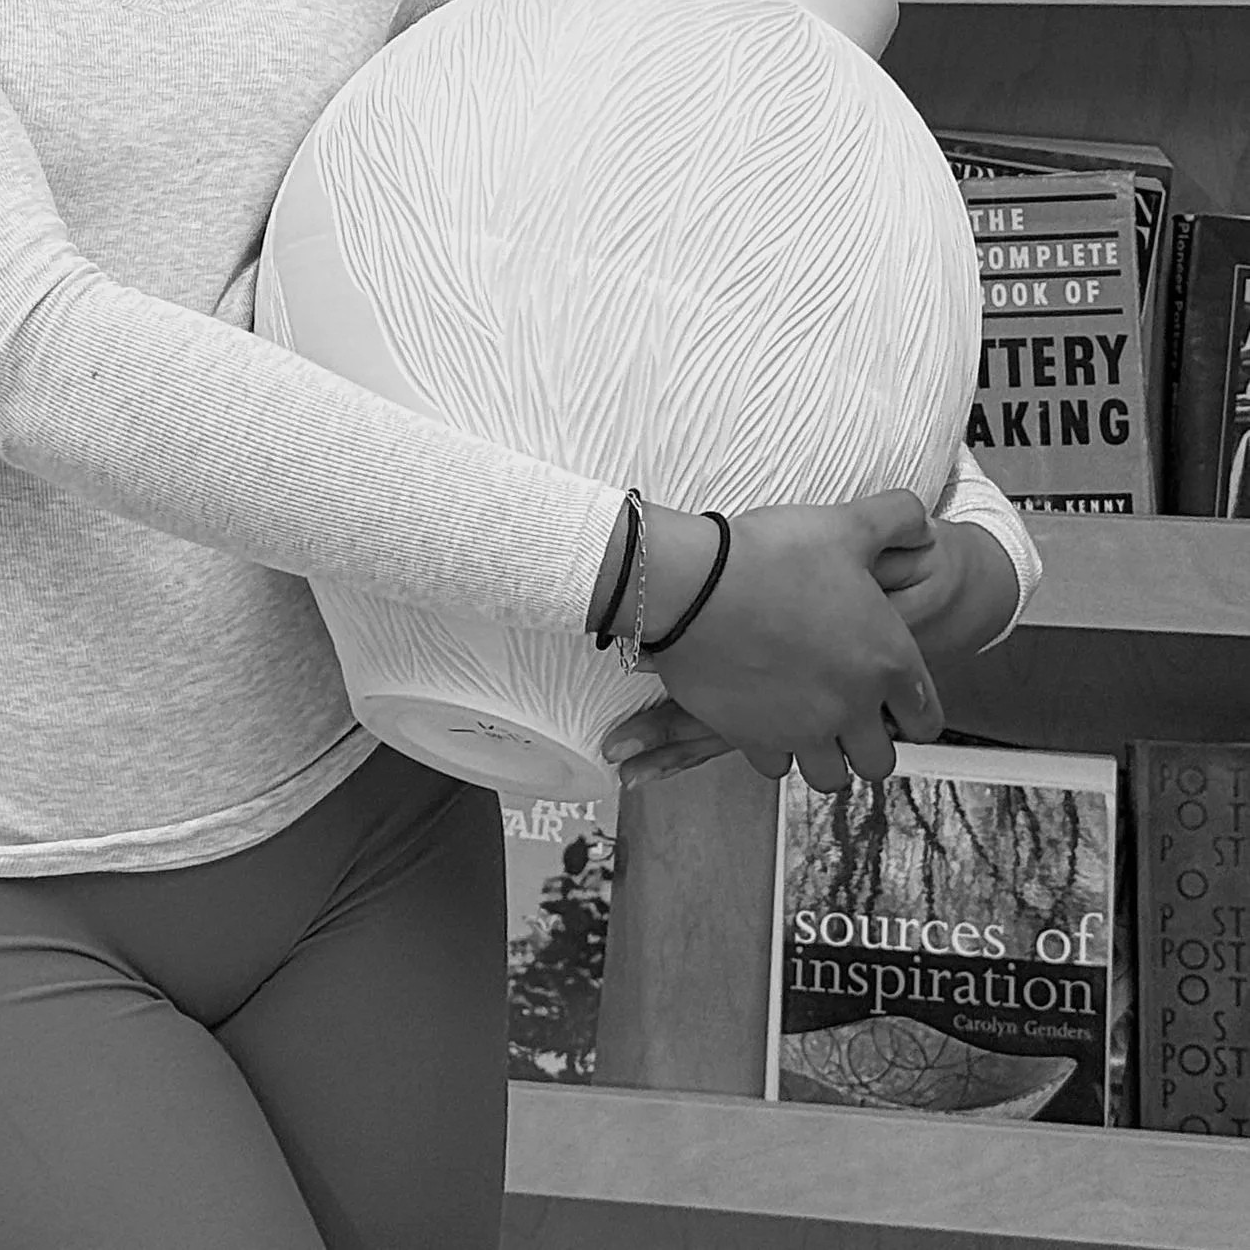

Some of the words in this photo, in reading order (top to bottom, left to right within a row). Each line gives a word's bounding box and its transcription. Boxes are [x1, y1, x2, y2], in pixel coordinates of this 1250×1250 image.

[968, 207, 1025, 233] THE
[1064, 280, 1100, 304] OF
[1065, 499, 1126, 514] KENNY
[793, 909, 1006, 960] sources
[1036, 912, 1104, 965] of
[790, 946, 1097, 1015] inspiration
[952, 1013, 1019, 1037] Carolyn
[1023, 1018, 1095, 1042] Genders
